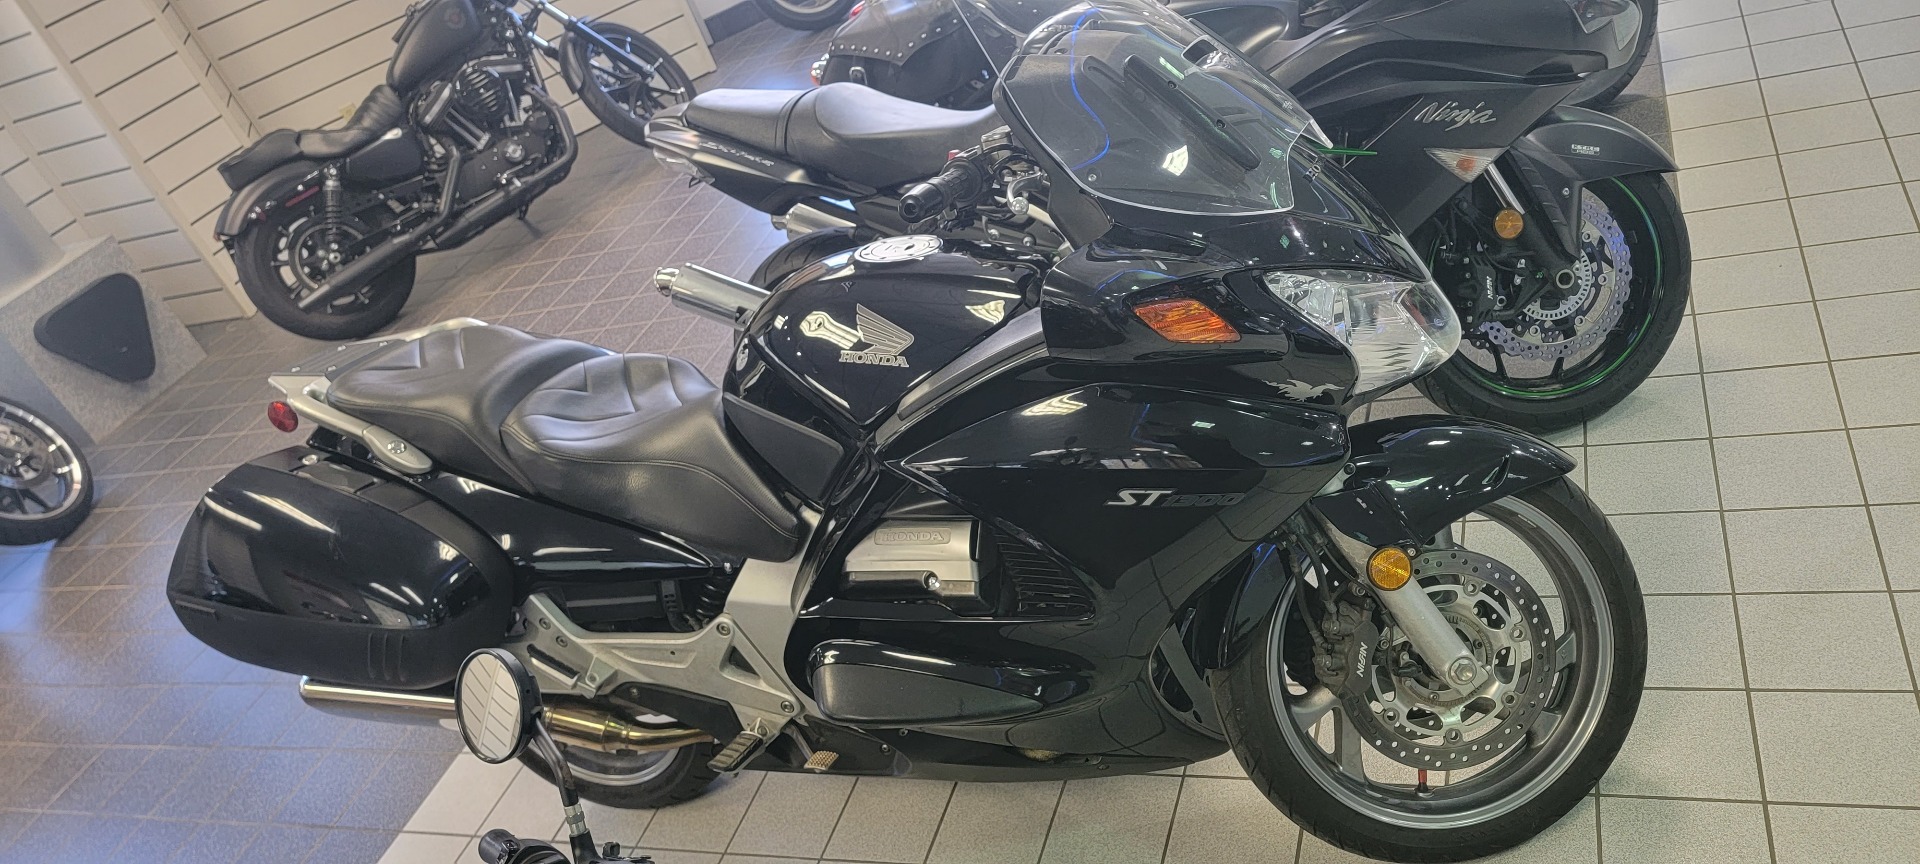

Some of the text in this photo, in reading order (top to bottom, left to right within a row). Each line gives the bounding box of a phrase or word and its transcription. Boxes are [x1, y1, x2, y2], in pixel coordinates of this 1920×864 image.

[1413, 101, 1497, 132] Ninja
[838, 350, 910, 368] HONDA
[880, 531, 945, 542] HONDA
[1356, 641, 1368, 678] NISSIN
